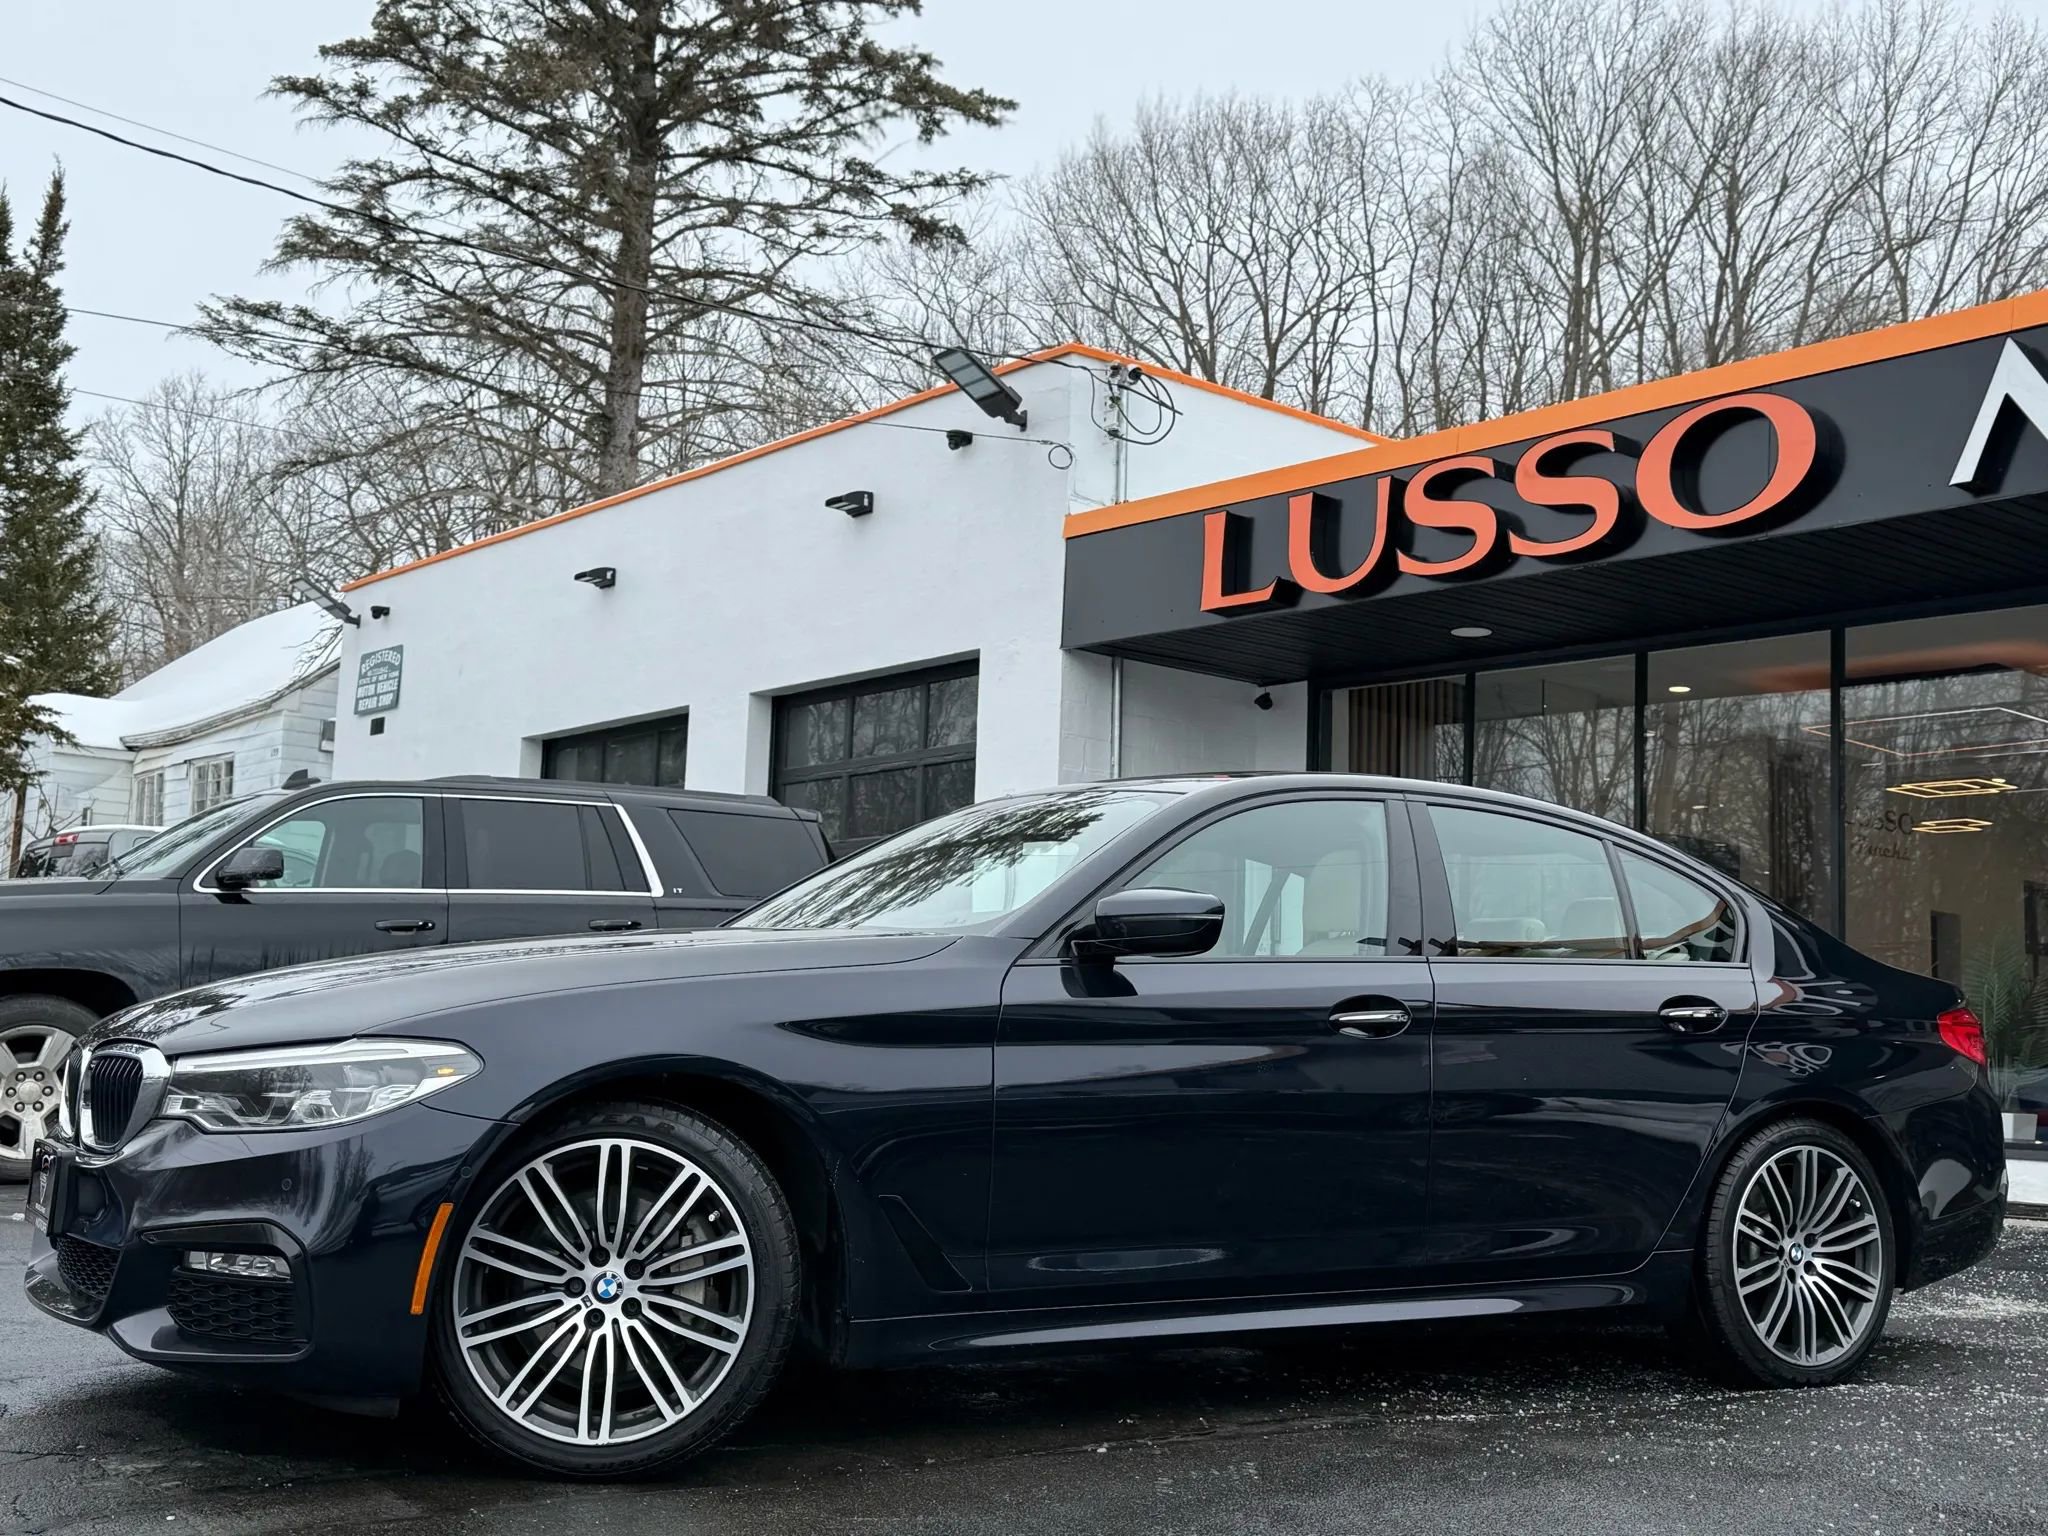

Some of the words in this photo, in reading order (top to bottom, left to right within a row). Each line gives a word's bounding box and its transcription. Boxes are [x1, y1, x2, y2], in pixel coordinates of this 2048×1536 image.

[1200, 392, 1817, 612] LUSSO
[361, 650, 401, 675] REGISTERED
[357, 683, 376, 698] MOTOR
[377, 678, 398, 694] VEHICLE
[358, 696, 378, 711] REPAIR
[378, 692, 393, 707] SHOP
